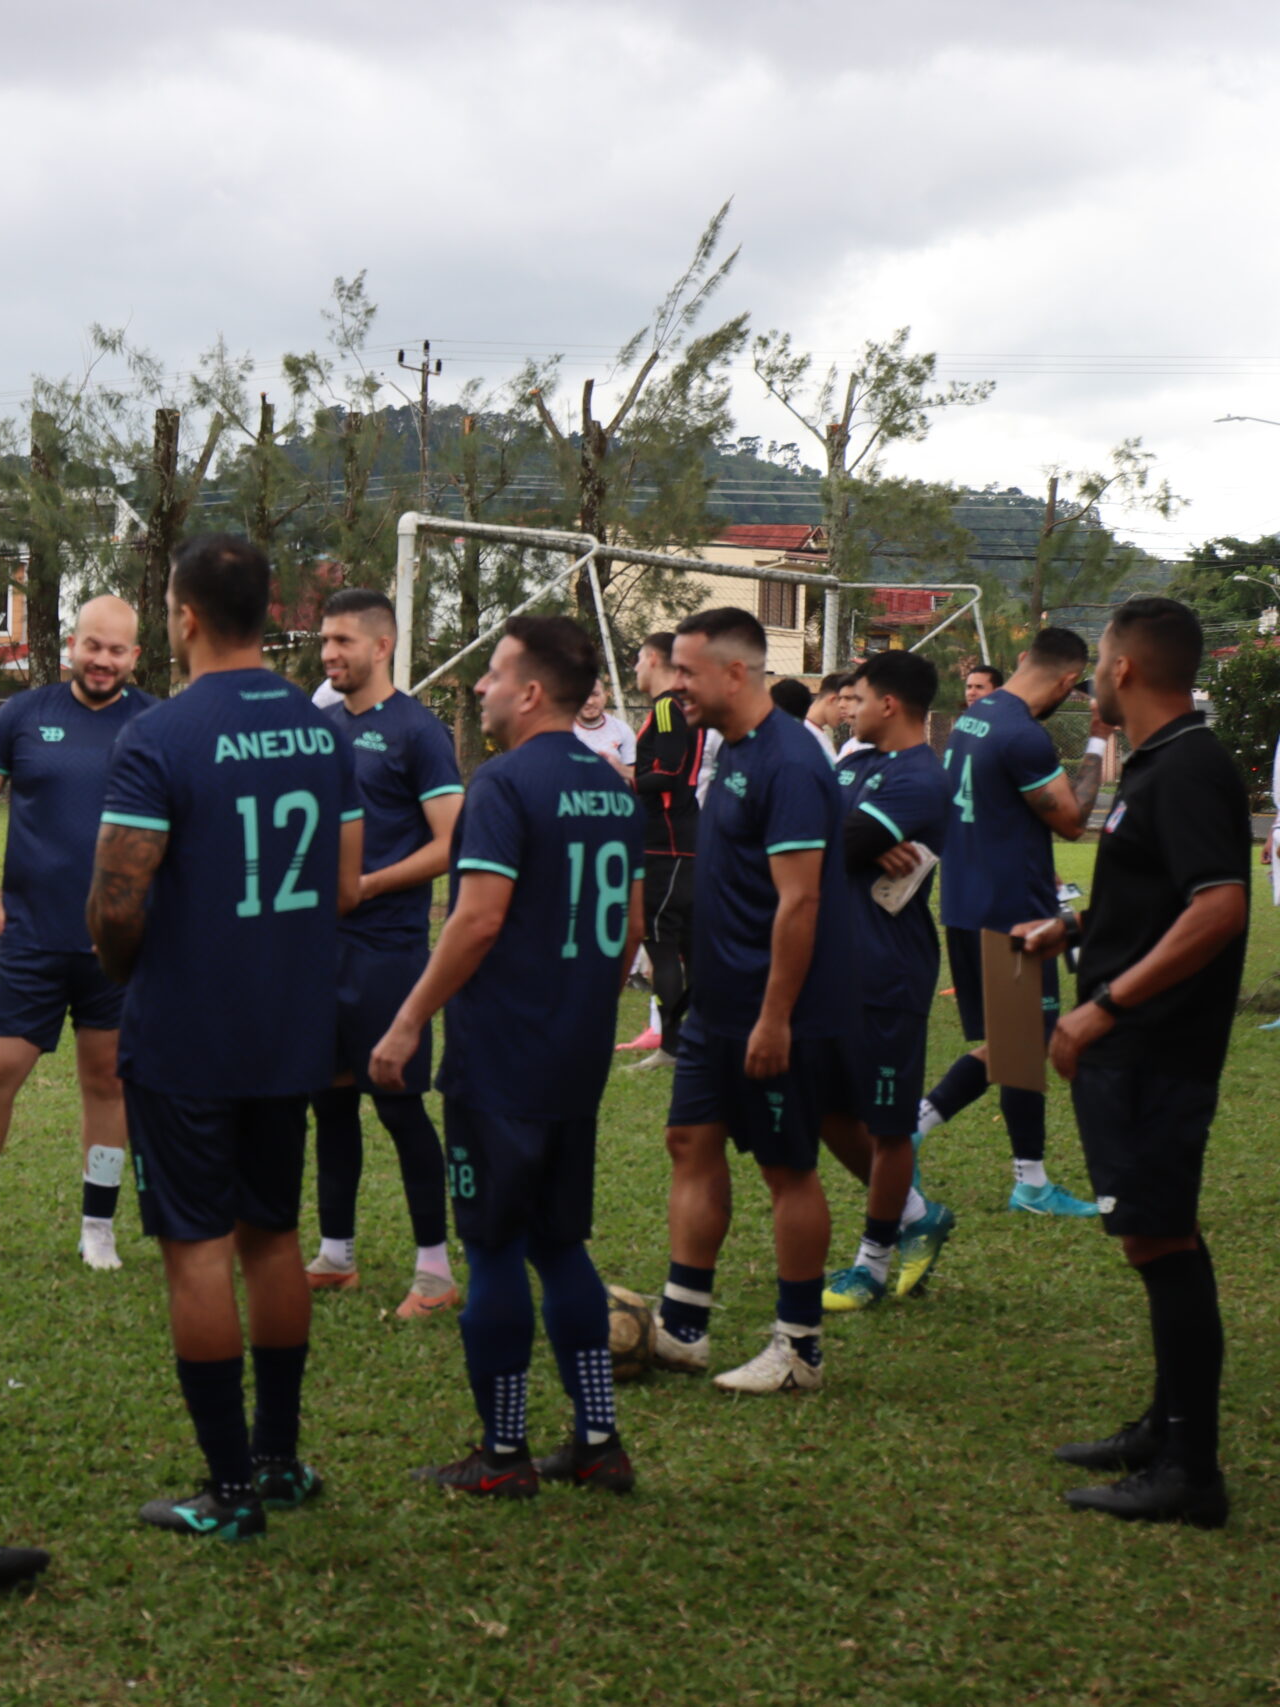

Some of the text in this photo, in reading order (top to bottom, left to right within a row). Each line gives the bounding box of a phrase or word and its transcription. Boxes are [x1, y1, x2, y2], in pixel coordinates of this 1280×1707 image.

[215, 727, 335, 764] ANEJUD
[557, 790, 635, 818] ANEJUD
[235, 789, 319, 917] 12
[561, 840, 629, 958] 18
[875, 1079, 895, 1105] 11
[449, 1164, 476, 1198] 18
